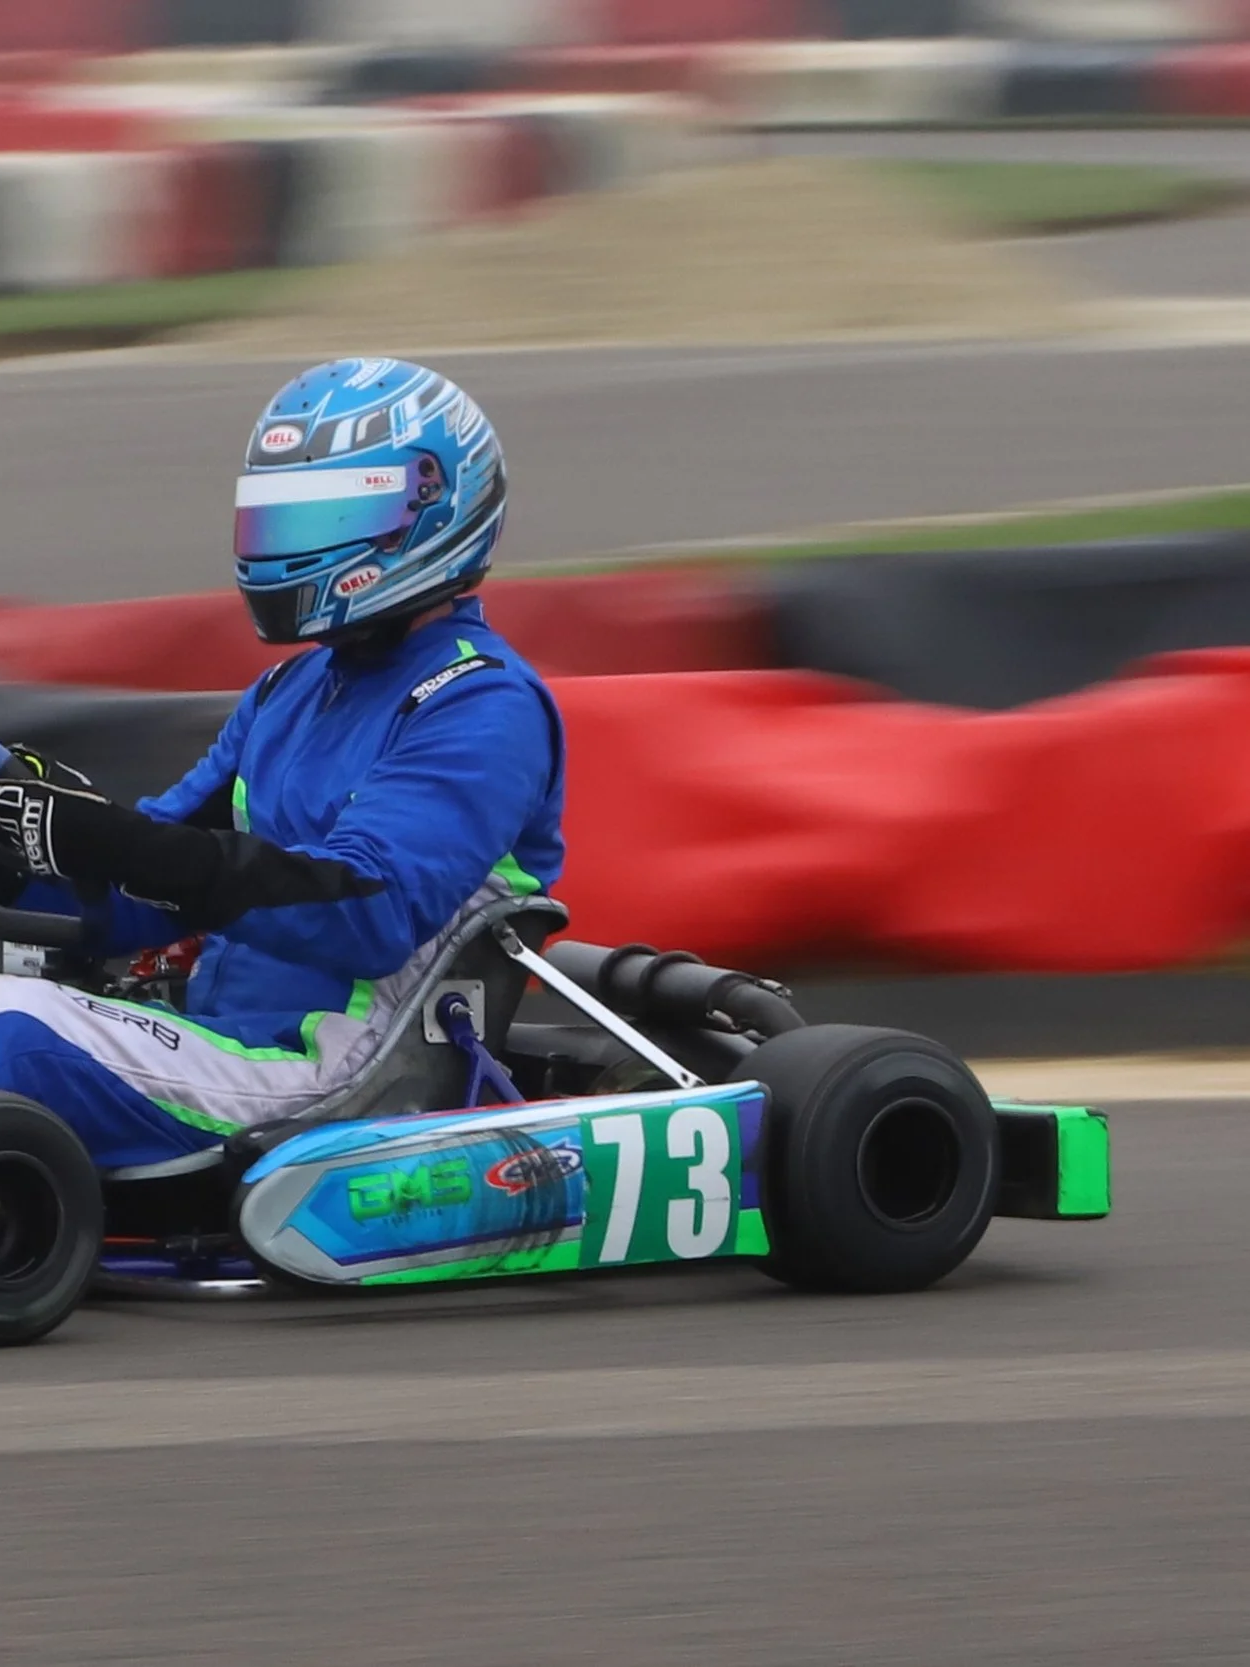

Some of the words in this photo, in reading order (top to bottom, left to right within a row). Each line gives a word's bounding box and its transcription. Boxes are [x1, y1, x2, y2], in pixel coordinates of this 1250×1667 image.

[265, 432, 295, 445] BELL
[364, 475, 394, 485] BELL
[339, 570, 377, 593] BELL
[22, 799, 52, 875] reem
[347, 1160, 472, 1221] GMS
[590, 1106, 731, 1262] 73
